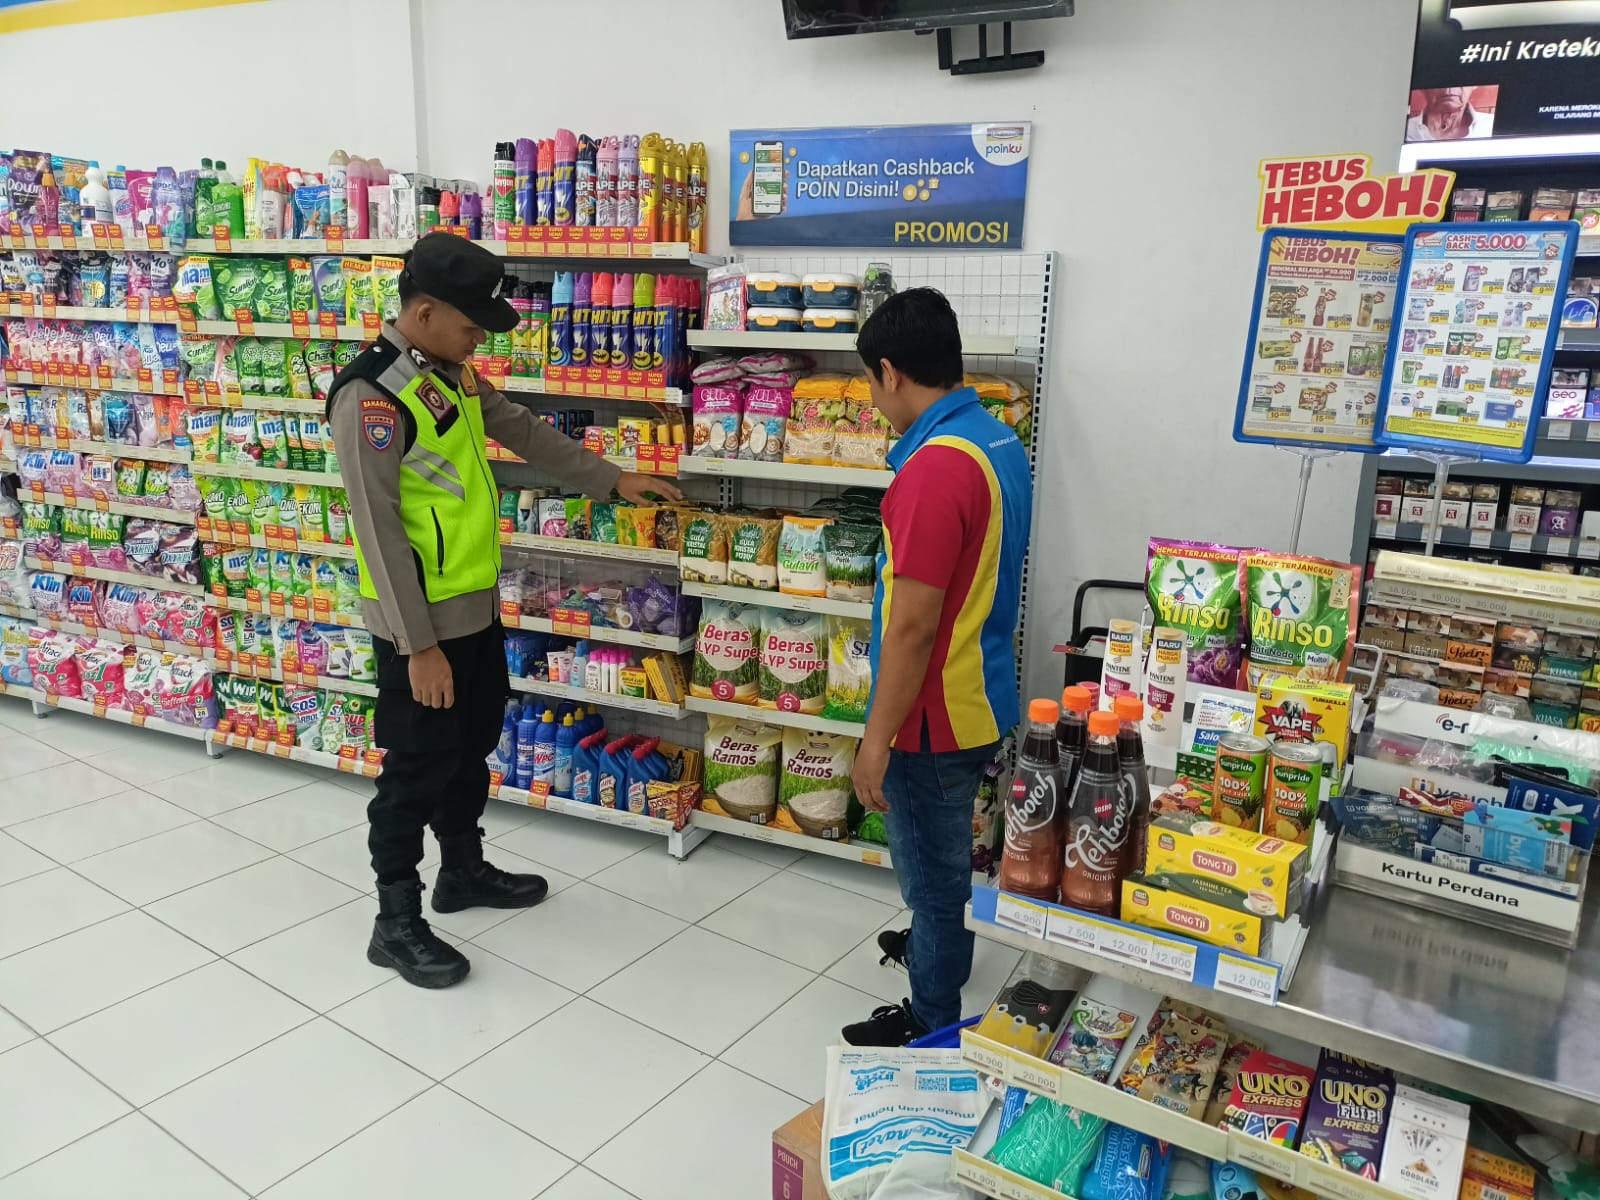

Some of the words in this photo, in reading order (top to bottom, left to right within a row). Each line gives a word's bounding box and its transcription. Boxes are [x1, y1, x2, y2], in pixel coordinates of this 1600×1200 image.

[1459, 40, 1513, 64] #Ini
[986, 144, 1023, 158] poinku
[797, 160, 877, 178] Dapatkan
[882, 157, 975, 177] Cashback
[1263, 158, 1366, 189] TEBUS
[576, 181, 594, 191] APE
[596, 180, 615, 191] APE
[617, 180, 636, 191] APE
[688, 187, 707, 197] APE
[796, 181, 841, 198] POIN
[845, 178, 900, 197] Disini!
[1262, 173, 1450, 225] HEBOH!
[894, 221, 1010, 243] PROMOSI
[1446, 242, 1471, 250] BACK
[1475, 234, 1527, 250] 5.000
[1284, 246, 1361, 266] HEBOH!
[633, 310, 655, 326] HIT
[90, 525, 119, 541] Rinso
[1156, 545, 1183, 555] HEMAT
[1184, 549, 1239, 562] TERJANGKAU
[782, 558, 820, 572] Gulavit
[1250, 558, 1279, 568] HEMAT
[1280, 561, 1334, 577] TERJANGKAU
[1157, 593, 1231, 630] Rinso
[703, 624, 750, 643] Beras
[1253, 607, 1333, 648] Rinso
[768, 635, 814, 655] Beras
[1111, 632, 1132, 642] BARU
[1158, 640, 1181, 649] BARU
[788, 657, 829, 674] Super
[1105, 663, 1131, 673] PANTENE
[1149, 671, 1175, 682] PANTENE
[718, 686, 728, 696] 5
[783, 699, 793, 710] 5
[1271, 714, 1313, 732] VAPE
[719, 735, 760, 753] Beras
[712, 748, 757, 766] Ramos
[795, 748, 834, 764] Beras
[786, 758, 833, 779] Ramos
[1220, 758, 1254, 772] Sunpride
[1275, 768, 1311, 783] Sunpride
[1219, 777, 1250, 791] 100%
[1274, 787, 1307, 803] 100%
[1094, 803, 1113, 814] SOSRO
[1196, 854, 1221, 870] TONG
[1082, 870, 1116, 881] ORIGINAL
[1220, 886, 1233, 894] TEA
[1381, 861, 1432, 887] Kartu
[1437, 876, 1520, 907] Perdana
[1169, 910, 1194, 925] TONG
[1066, 925, 1095, 941] 7.500
[1112, 938, 1149, 957] 12.000
[1154, 952, 1192, 969] 12.000
[1232, 972, 1272, 992] 12.000
[1237, 1071, 1310, 1097] UNO
[1242, 1095, 1302, 1108] EXPRESS
[1321, 1078, 1387, 1109] UNO
[854, 1105, 895, 1125] hemat
[898, 1104, 925, 1112] dan
[928, 1105, 976, 1119] mudah
[1323, 1117, 1380, 1134] EXPRESS
